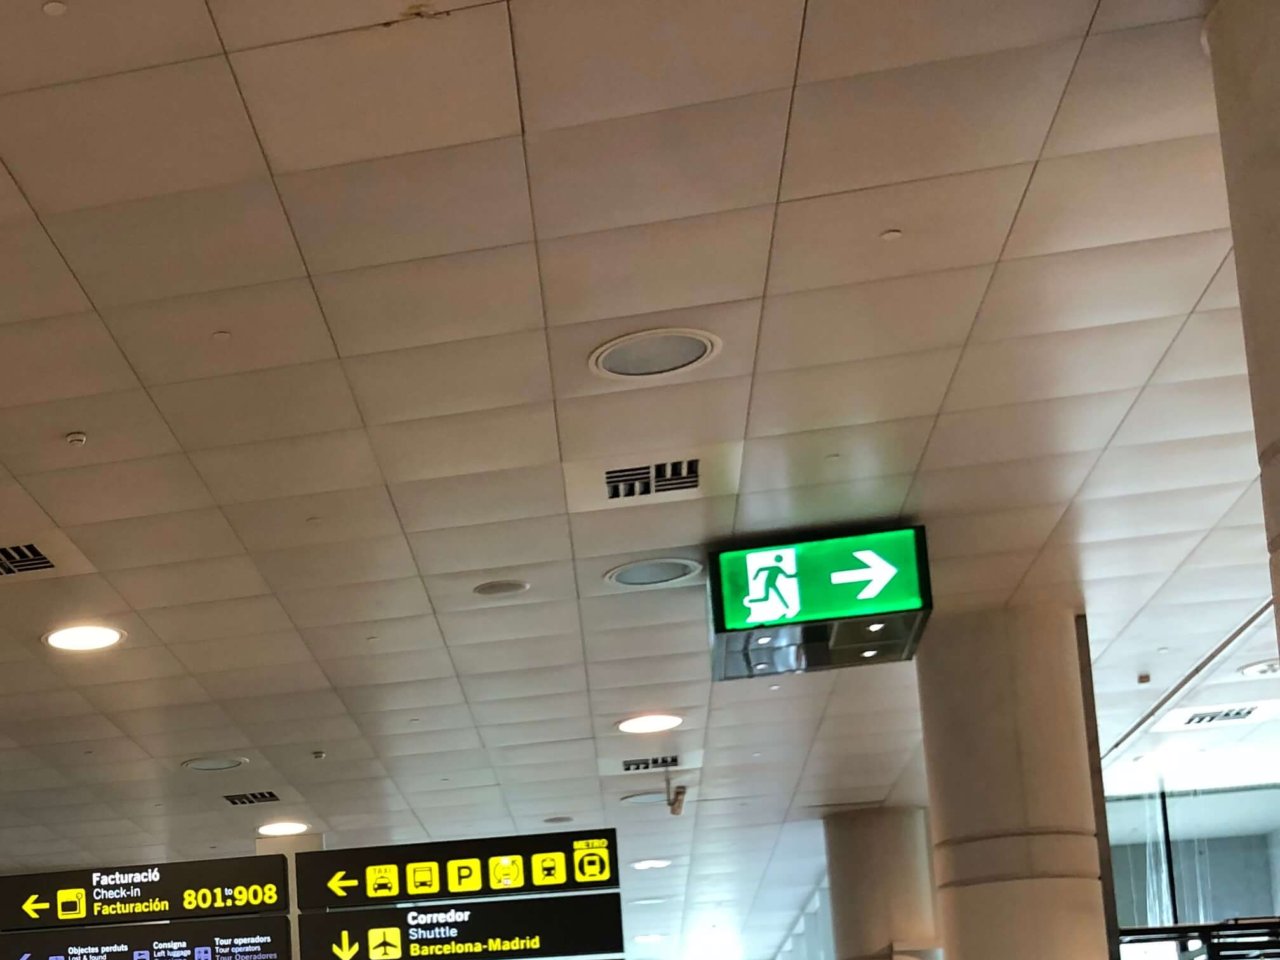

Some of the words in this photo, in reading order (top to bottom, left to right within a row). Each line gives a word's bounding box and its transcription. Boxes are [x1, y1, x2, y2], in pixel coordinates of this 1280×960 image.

[92, 868, 160, 885] Facturació
[93, 887, 141, 900] Check-in
[183, 887, 225, 909] 801
[233, 883, 278, 906] 908
[93, 899, 169, 915] Facturación
[407, 909, 470, 926] Corredor
[408, 926, 458, 940] Shuttle
[153, 940, 187, 949] Consigna
[214, 937, 232, 946] Tour
[233, 935, 271, 945] operadors
[409, 935, 540, 957] Barcelona-Madrid
[100, 944, 128, 954] perduts
[153, 950, 166, 958] Left
[167, 949, 191, 958] luggage
[231, 945, 261, 954] operators
